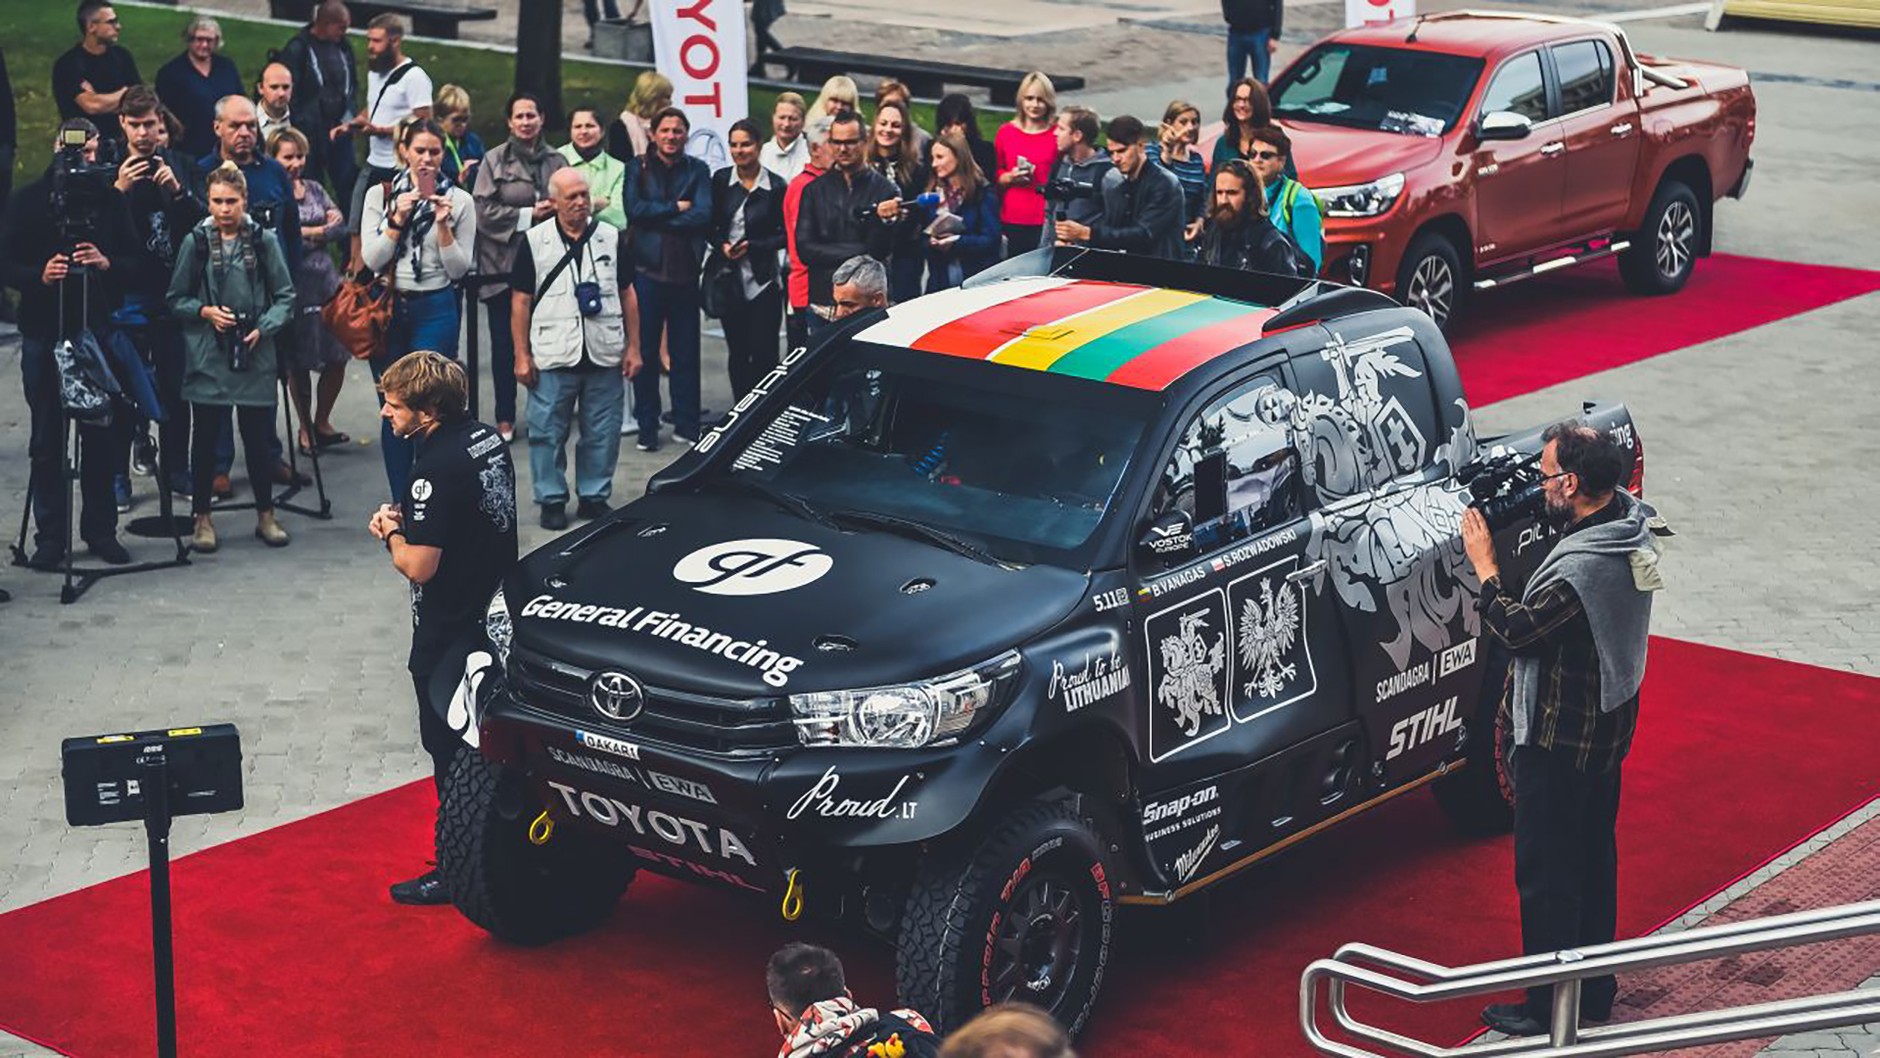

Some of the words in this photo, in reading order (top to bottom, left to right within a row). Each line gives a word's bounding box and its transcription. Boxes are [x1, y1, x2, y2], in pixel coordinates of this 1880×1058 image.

[1149, 532, 1193, 549] VOSTOK
[1155, 542, 1189, 553] EUROPE
[1223, 529, 1297, 567] S.ROZWADOWSKI
[680, 544, 829, 592] gf
[1152, 566, 1206, 597] B.VANAGAS
[521, 594, 644, 629] General
[633, 610, 804, 688] Financing
[1048, 652, 1092, 700] Proud
[1095, 656, 1107, 677] to
[1376, 661, 1429, 703] SCANDAGRA
[1442, 641, 1474, 675] EWA
[1386, 695, 1463, 761] STIHL
[548, 747, 637, 783] SCANDAGRA
[655, 773, 715, 803] EWA
[548, 780, 758, 867] TOYOTA
[1142, 785, 1219, 825] Snap-on
[1182, 807, 1221, 828] SOLUTIONS
